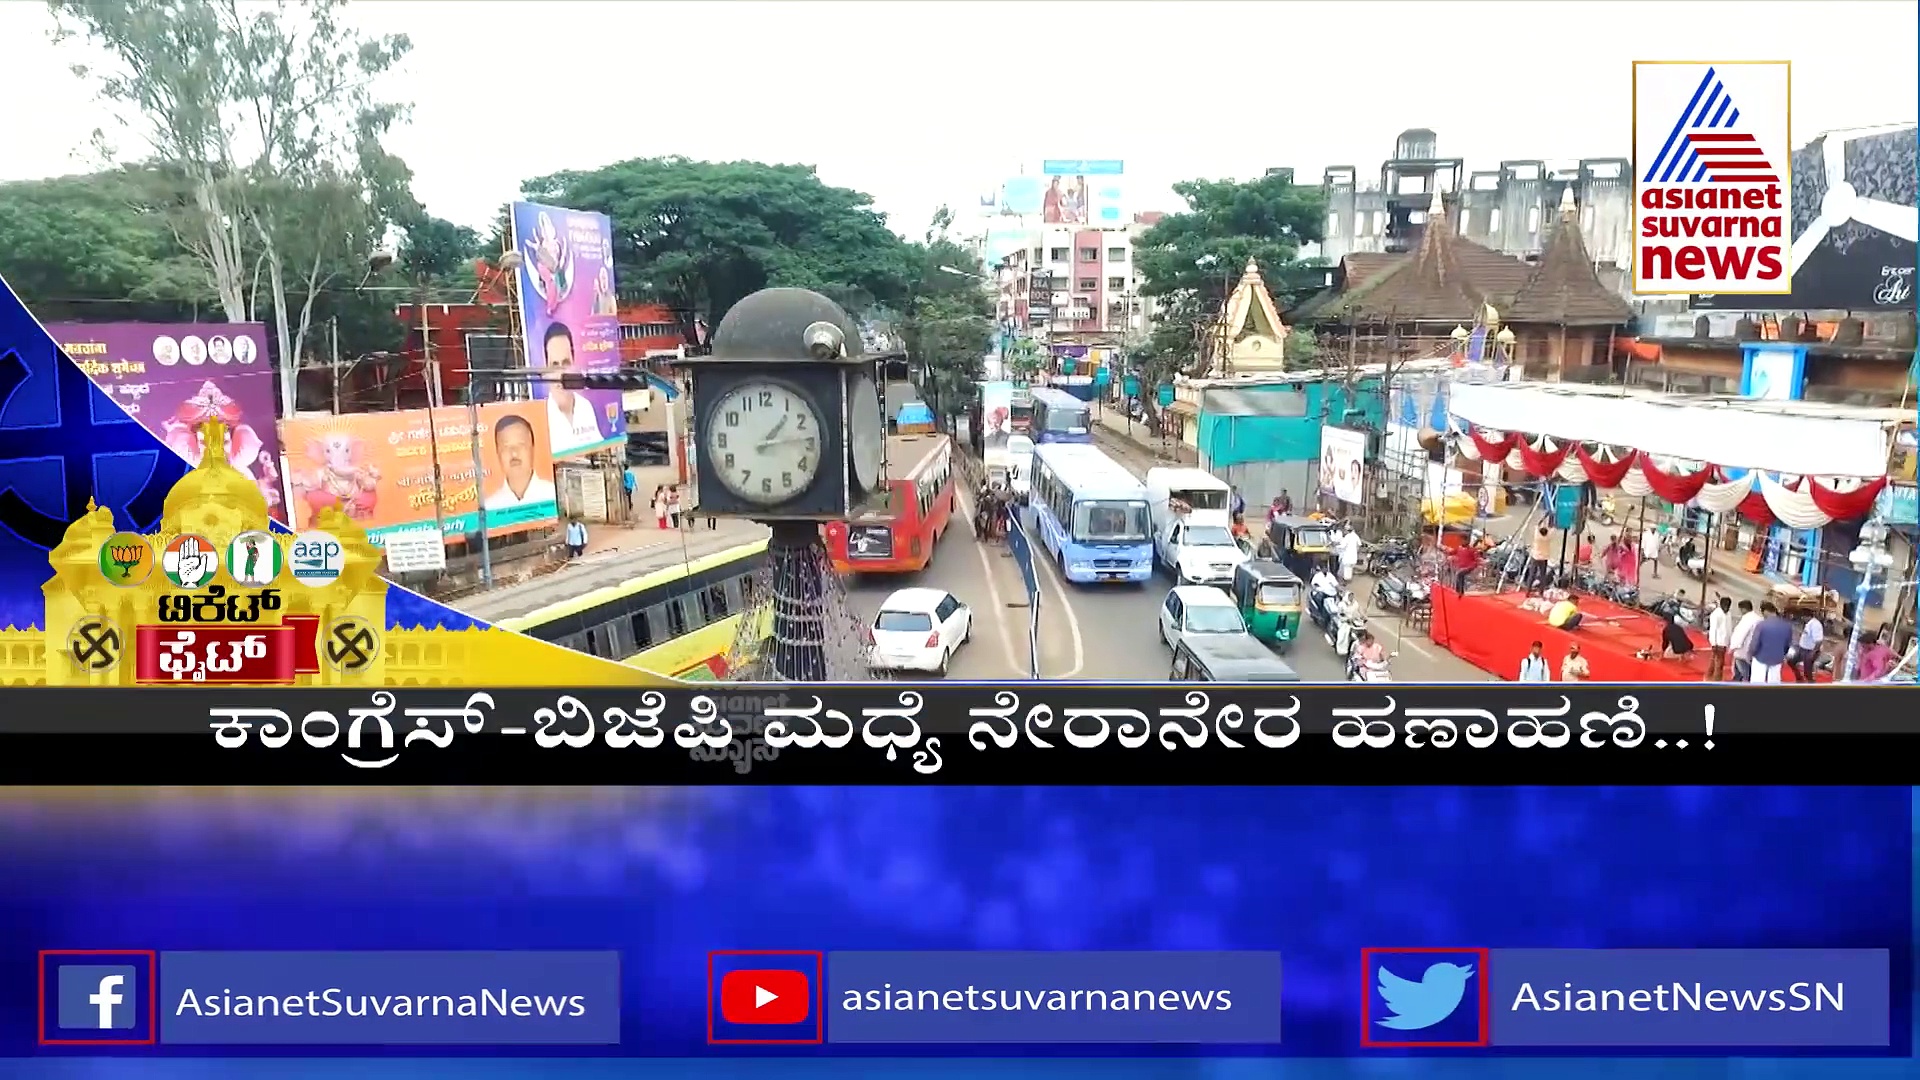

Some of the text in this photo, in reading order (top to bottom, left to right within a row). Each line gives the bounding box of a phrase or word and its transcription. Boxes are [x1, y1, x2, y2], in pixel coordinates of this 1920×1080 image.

[742, 396, 752, 412] 11
[758, 391, 773, 407] 12
[725, 411, 739, 427] 10
[796, 413, 807, 430] 2
[718, 433, 727, 448] 9
[805, 437, 815, 451] 3
[725, 453, 734, 468] 8
[798, 456, 808, 472] 4
[741, 470, 751, 485] 7
[782, 472, 791, 487] 5
[762, 478, 771, 493] 6
